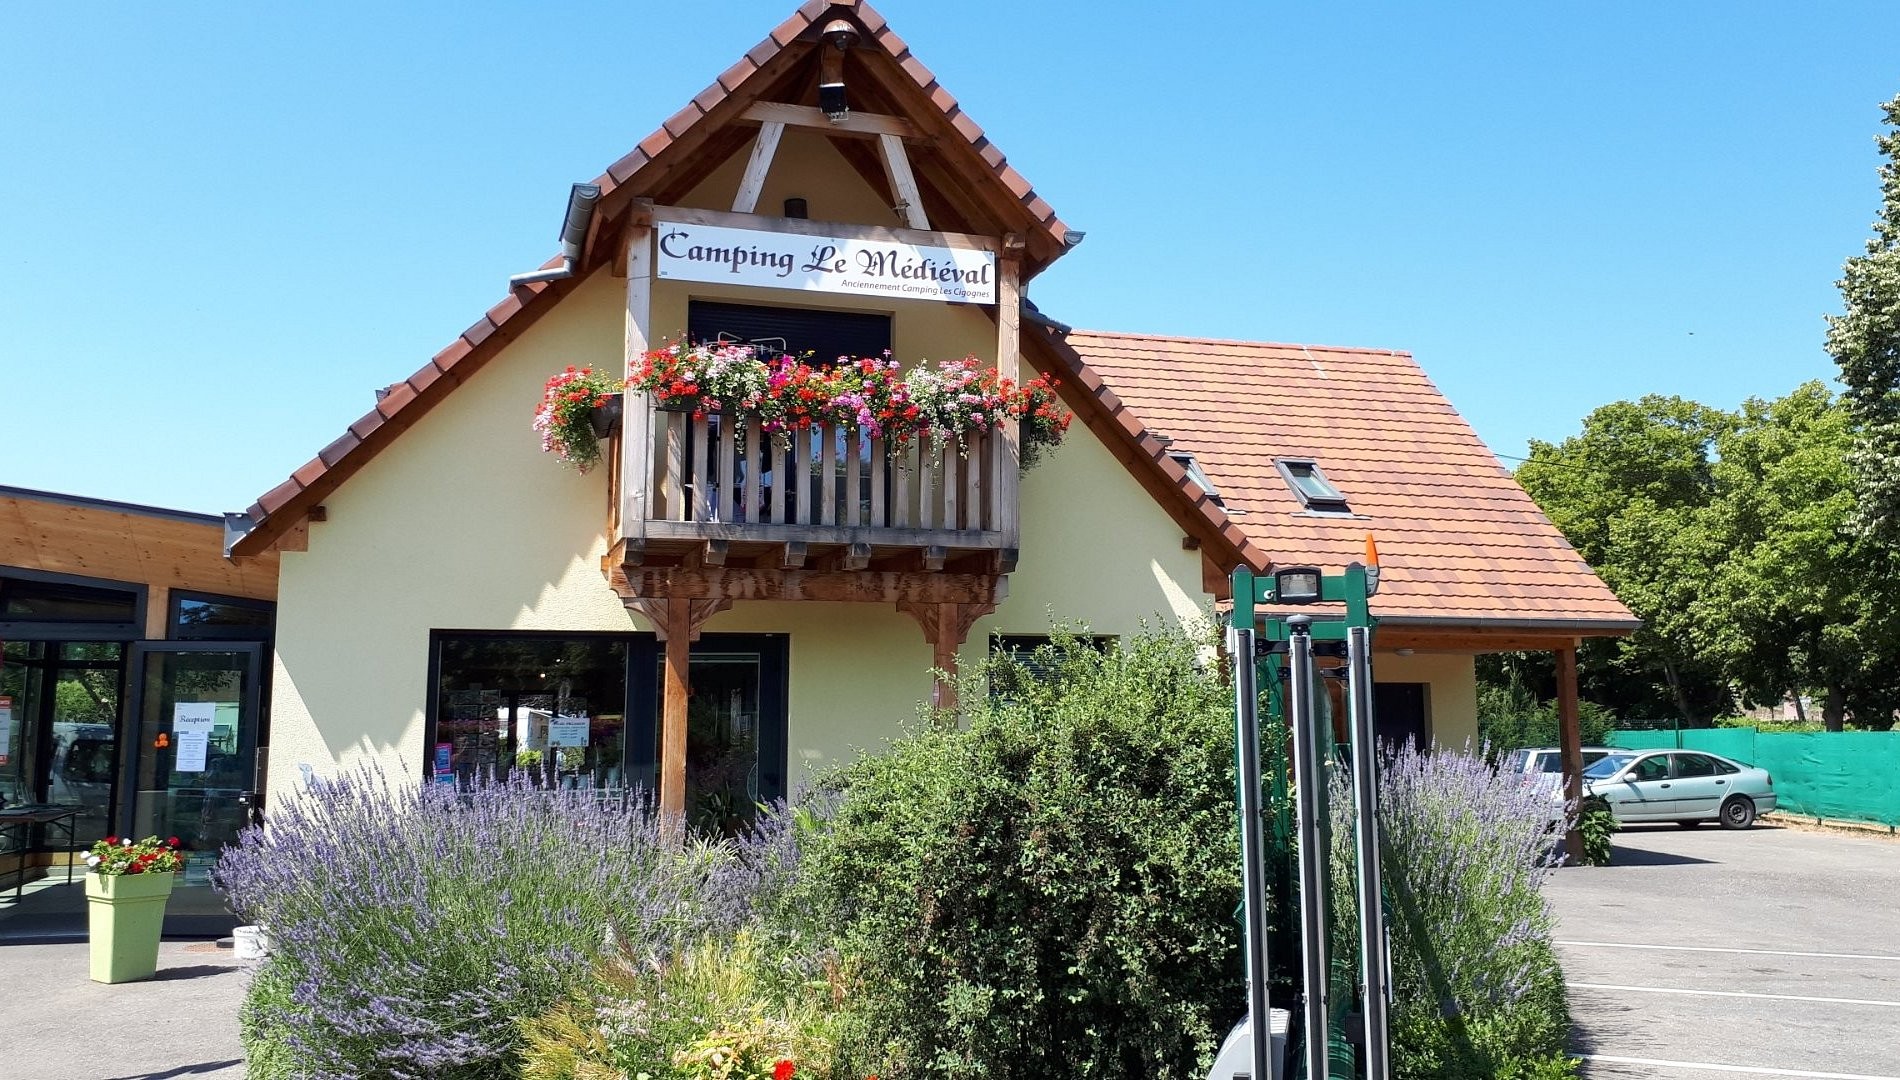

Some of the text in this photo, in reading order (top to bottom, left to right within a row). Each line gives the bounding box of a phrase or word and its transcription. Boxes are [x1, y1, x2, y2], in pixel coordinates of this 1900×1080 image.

[660, 228, 991, 285] Camping Le Médiéval
[841, 279, 990, 298] Anciennement Camping Les Cigognes
